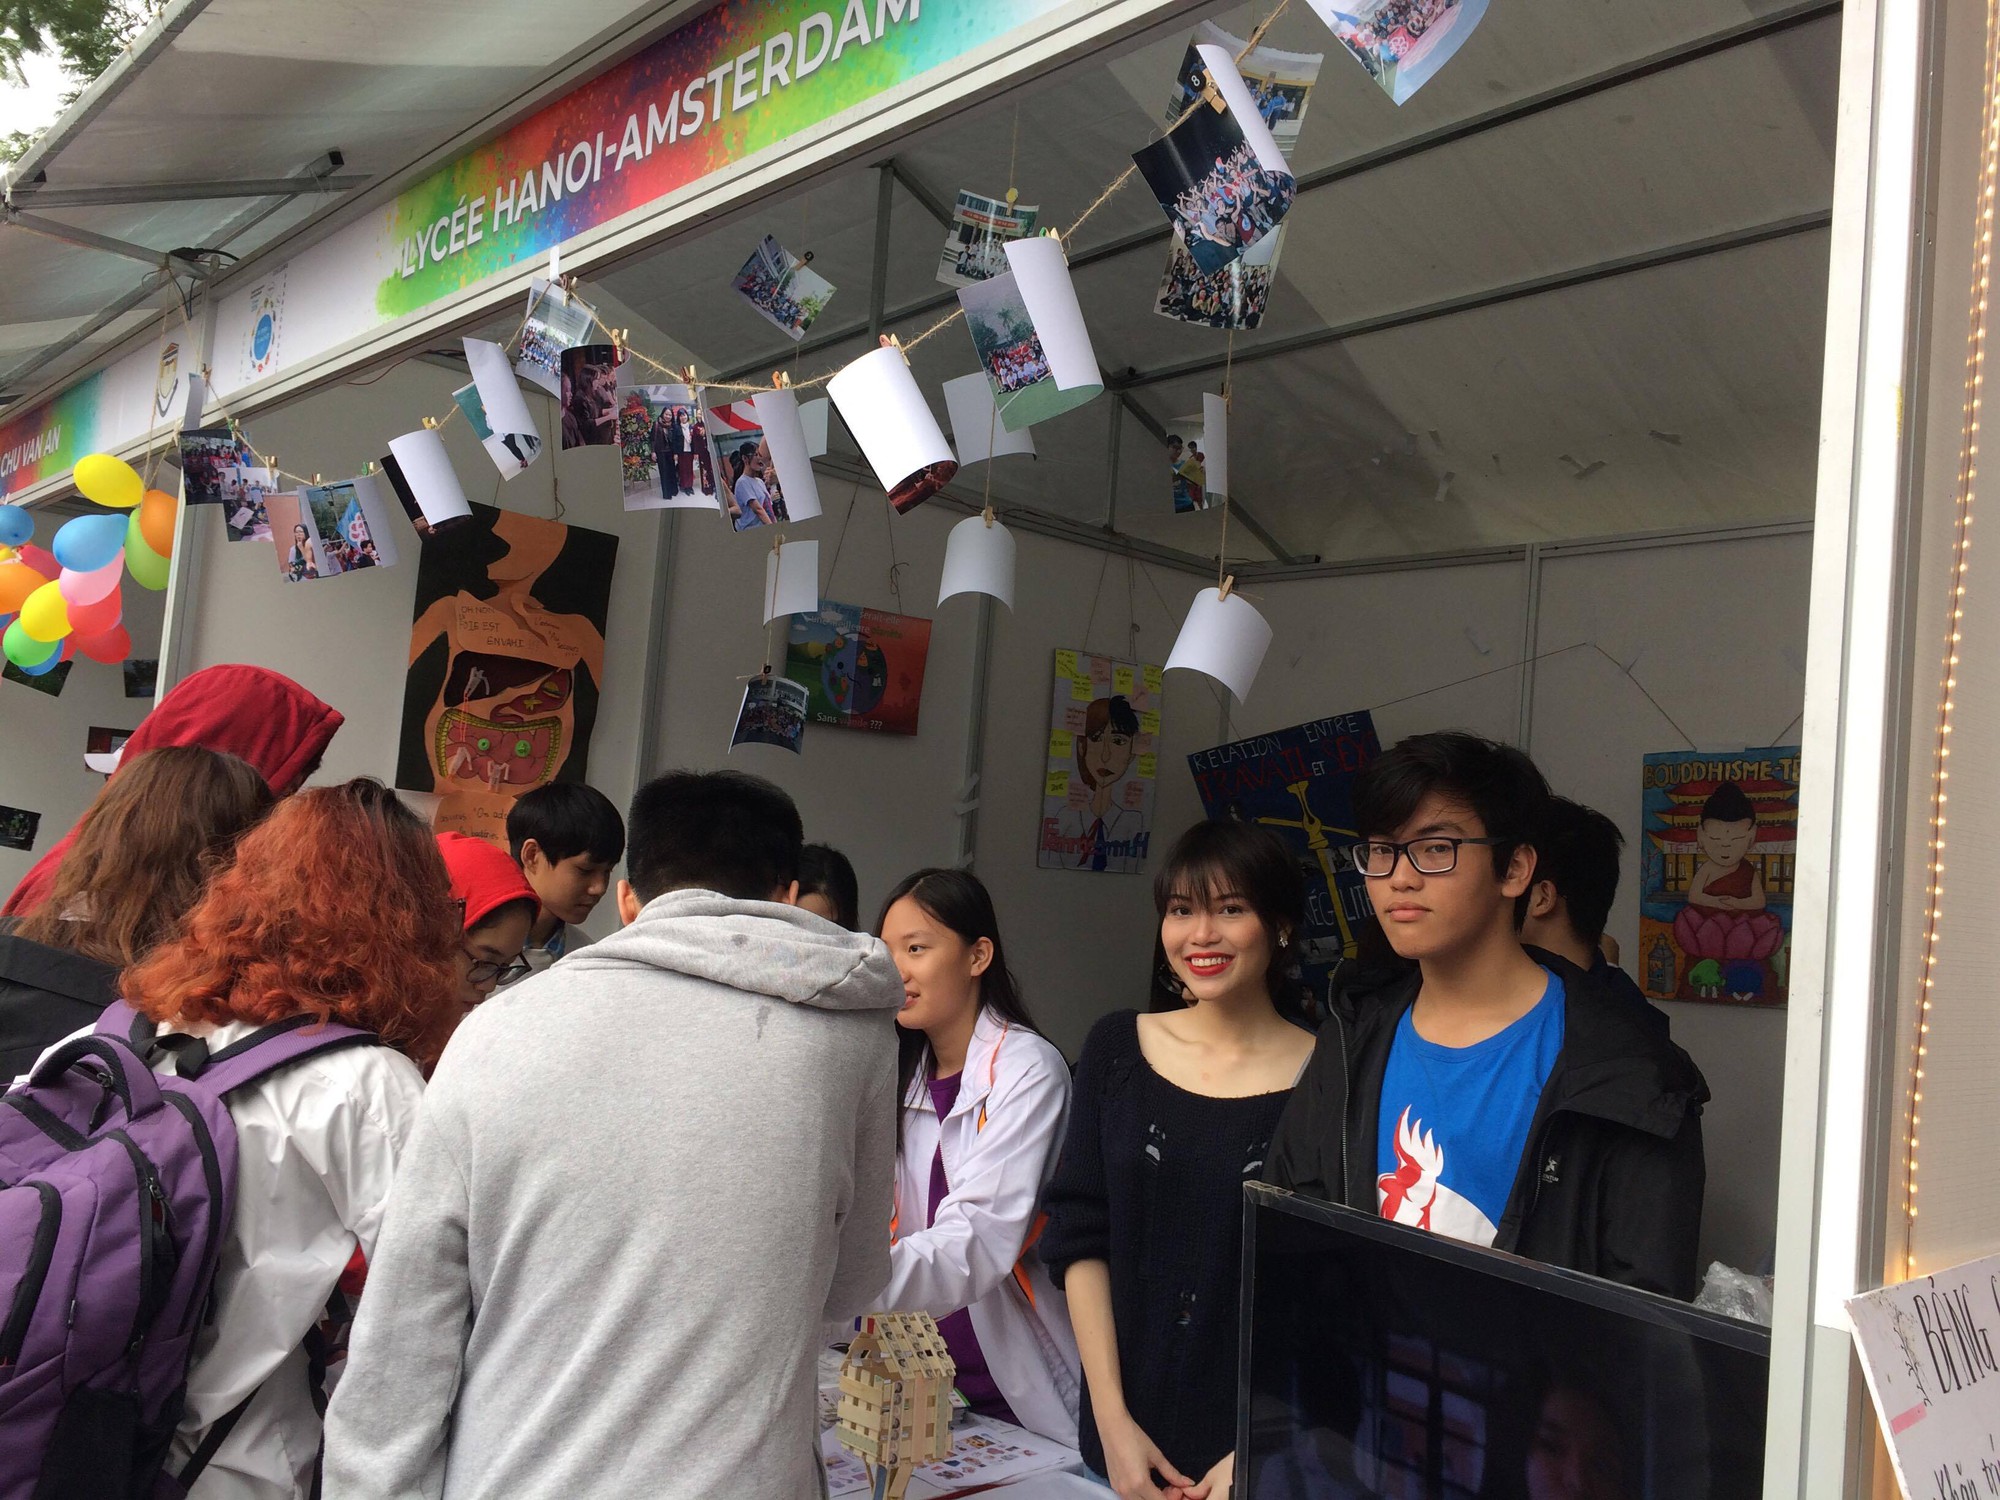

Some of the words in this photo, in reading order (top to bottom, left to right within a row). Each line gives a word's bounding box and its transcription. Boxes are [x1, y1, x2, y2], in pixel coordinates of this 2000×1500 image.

[401, 187, 485, 279] LYCÉE
[493, 0, 922, 233] HANOI-AMSTERDAM
[1, 446, 22, 477] CHU
[23, 433, 44, 466] VAN
[44, 424, 62, 456] AN
[816, 712, 838, 724] Sans
[1193, 735, 1283, 772] RELATION
[1302, 714, 1360, 743] ENTRE
[1311, 760, 1326, 777] ET
